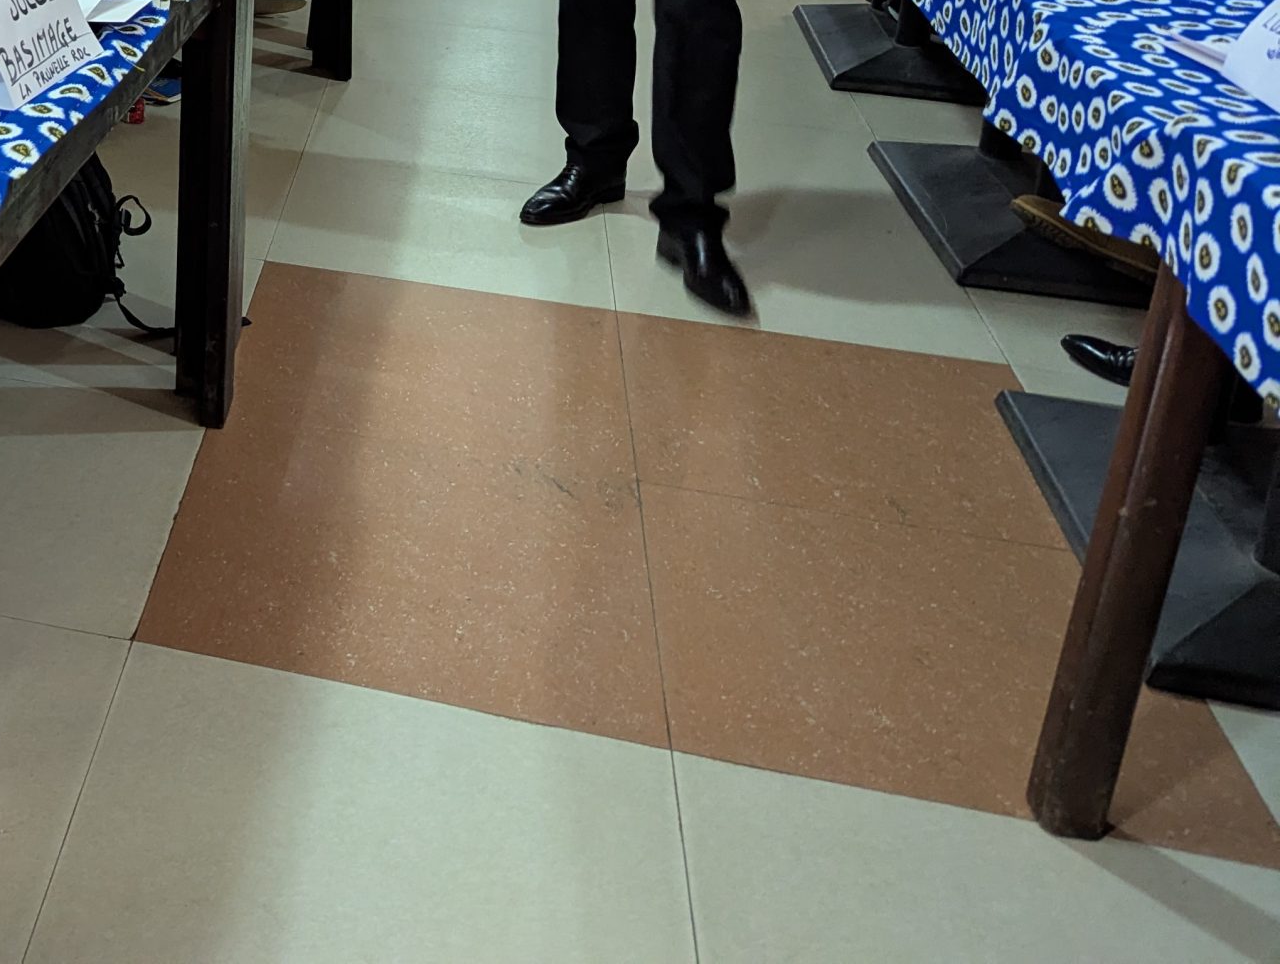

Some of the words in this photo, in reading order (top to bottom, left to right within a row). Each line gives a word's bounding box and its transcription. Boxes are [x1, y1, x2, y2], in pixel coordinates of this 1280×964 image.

[19, 82, 33, 101] LA
[32, 54, 71, 88] PRUNELLE
[70, 46, 92, 62] RDC
